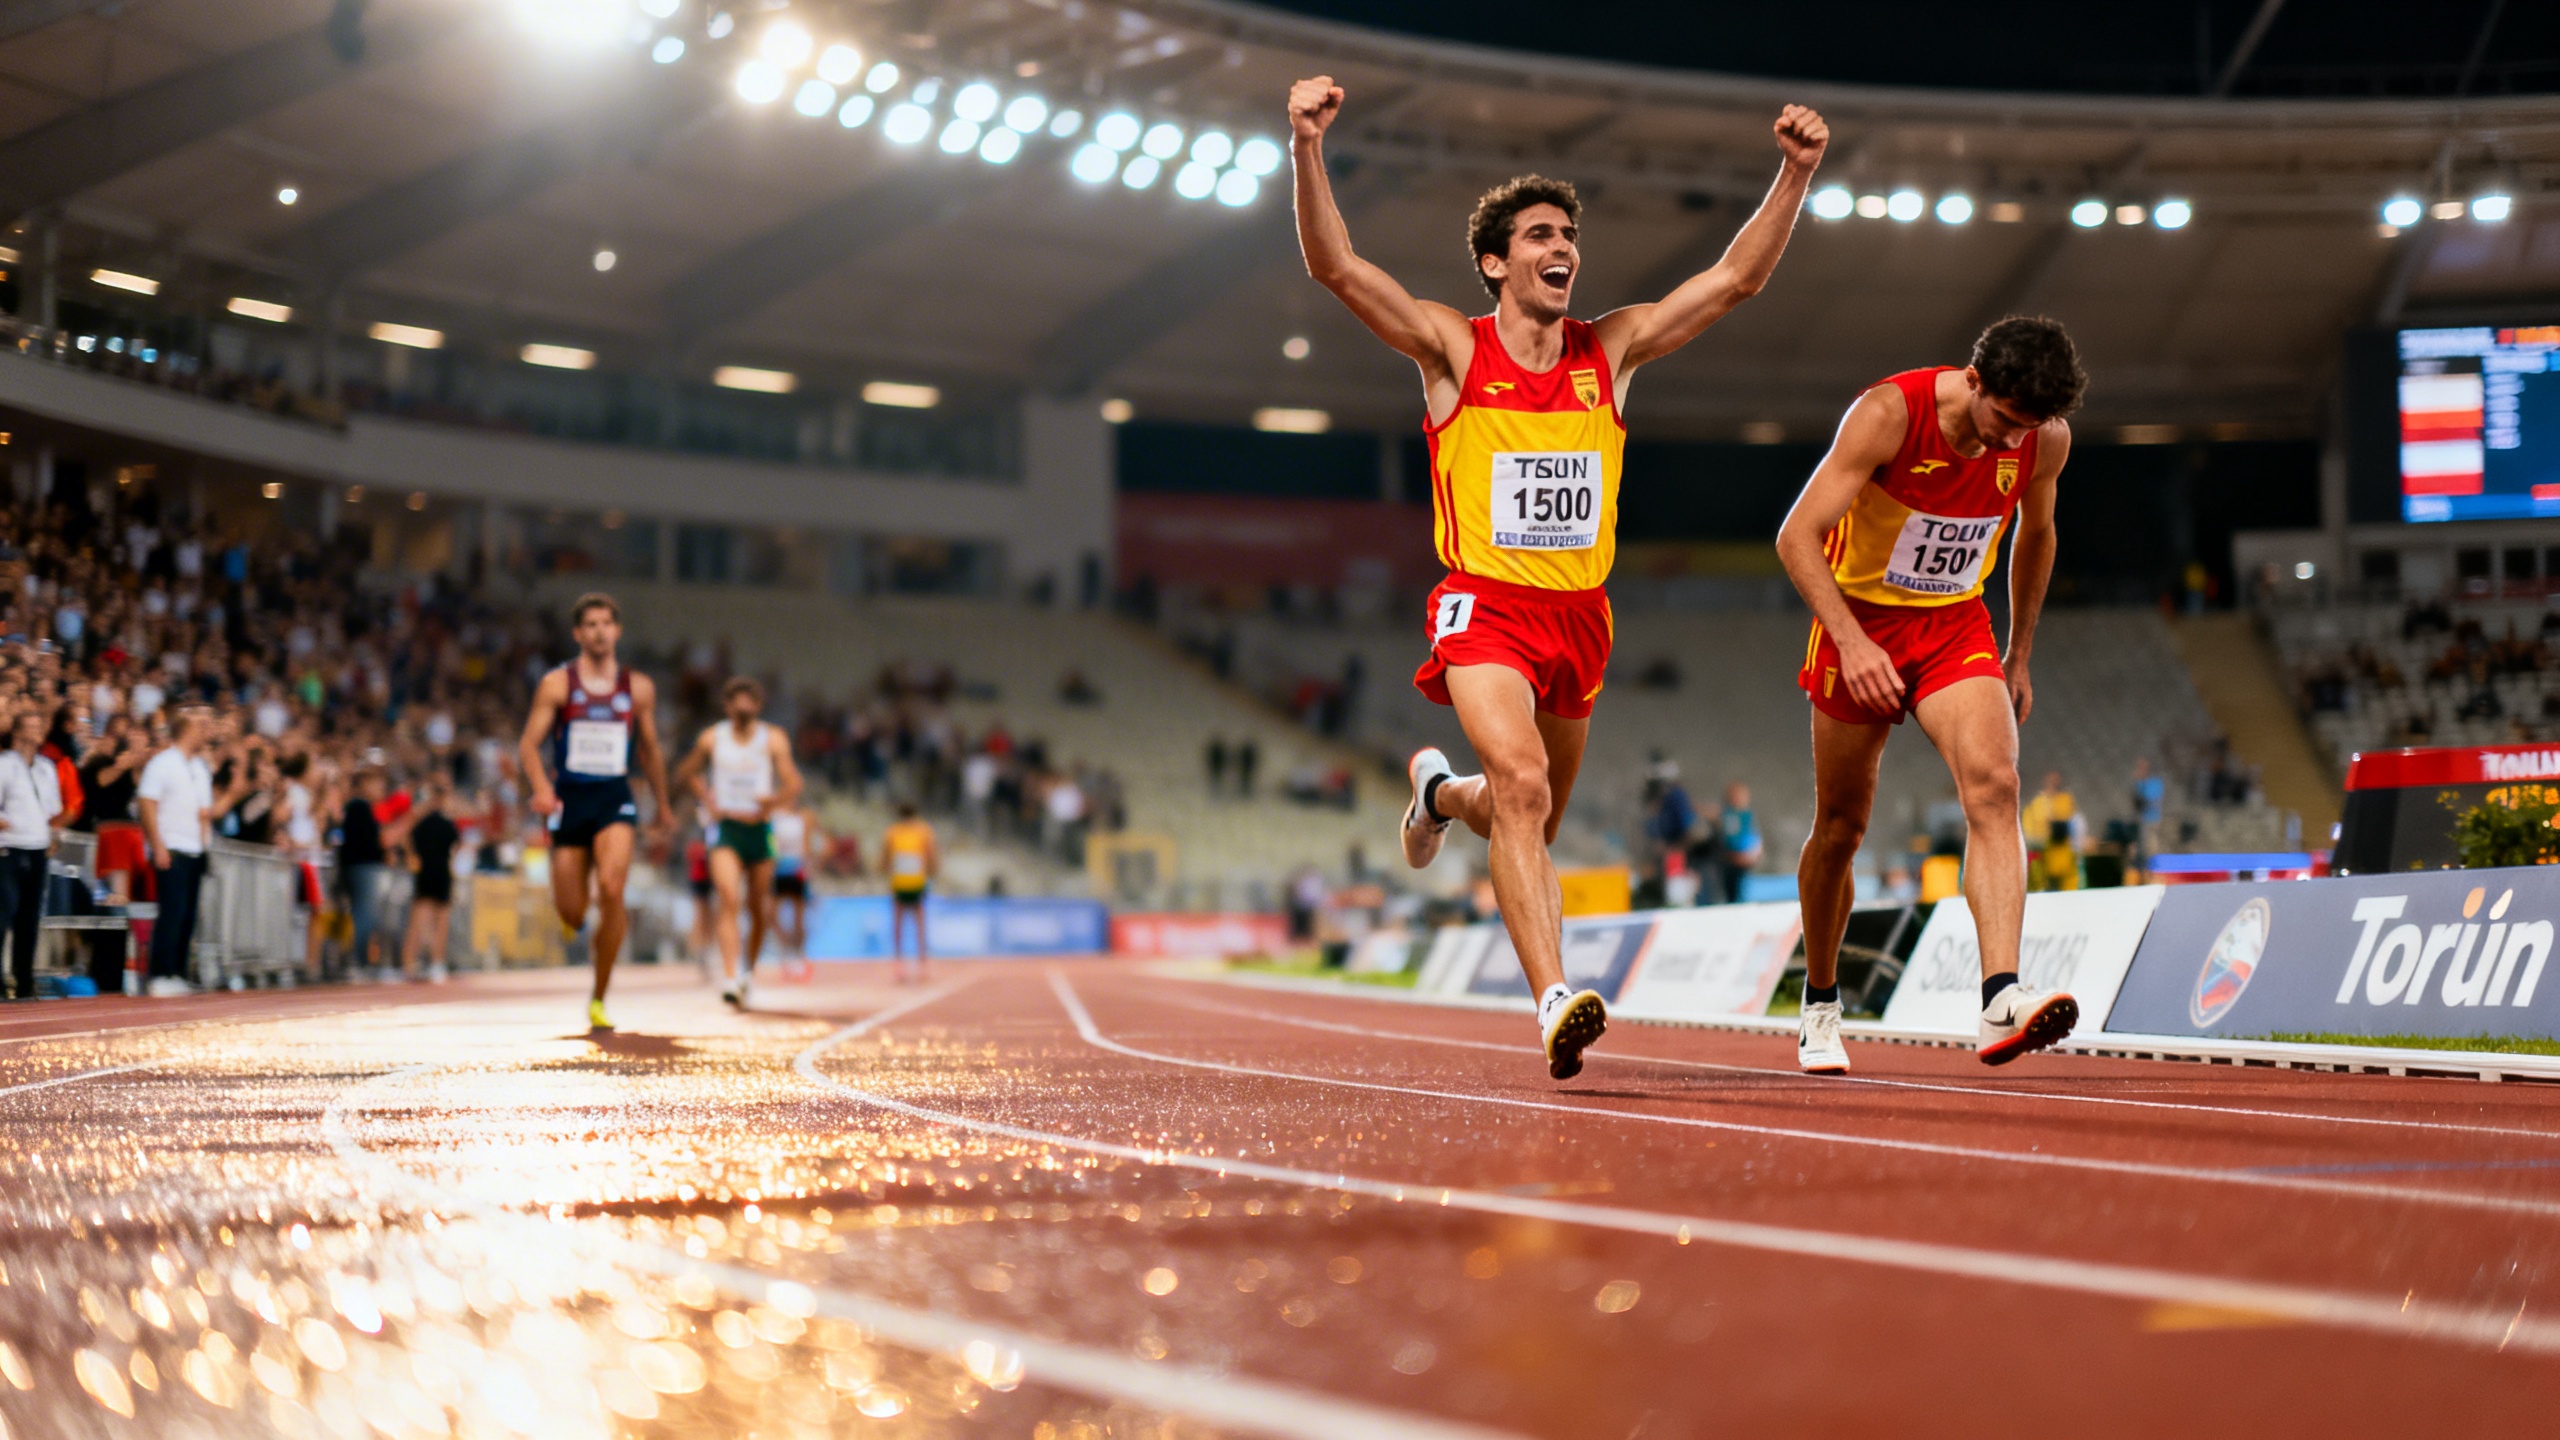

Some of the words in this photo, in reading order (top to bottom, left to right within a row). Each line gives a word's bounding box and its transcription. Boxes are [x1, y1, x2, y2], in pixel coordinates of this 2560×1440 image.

[1513, 487, 1592, 522] 1500
[1446, 599, 1462, 628] 1
[2335, 887, 2554, 1008] Torün
